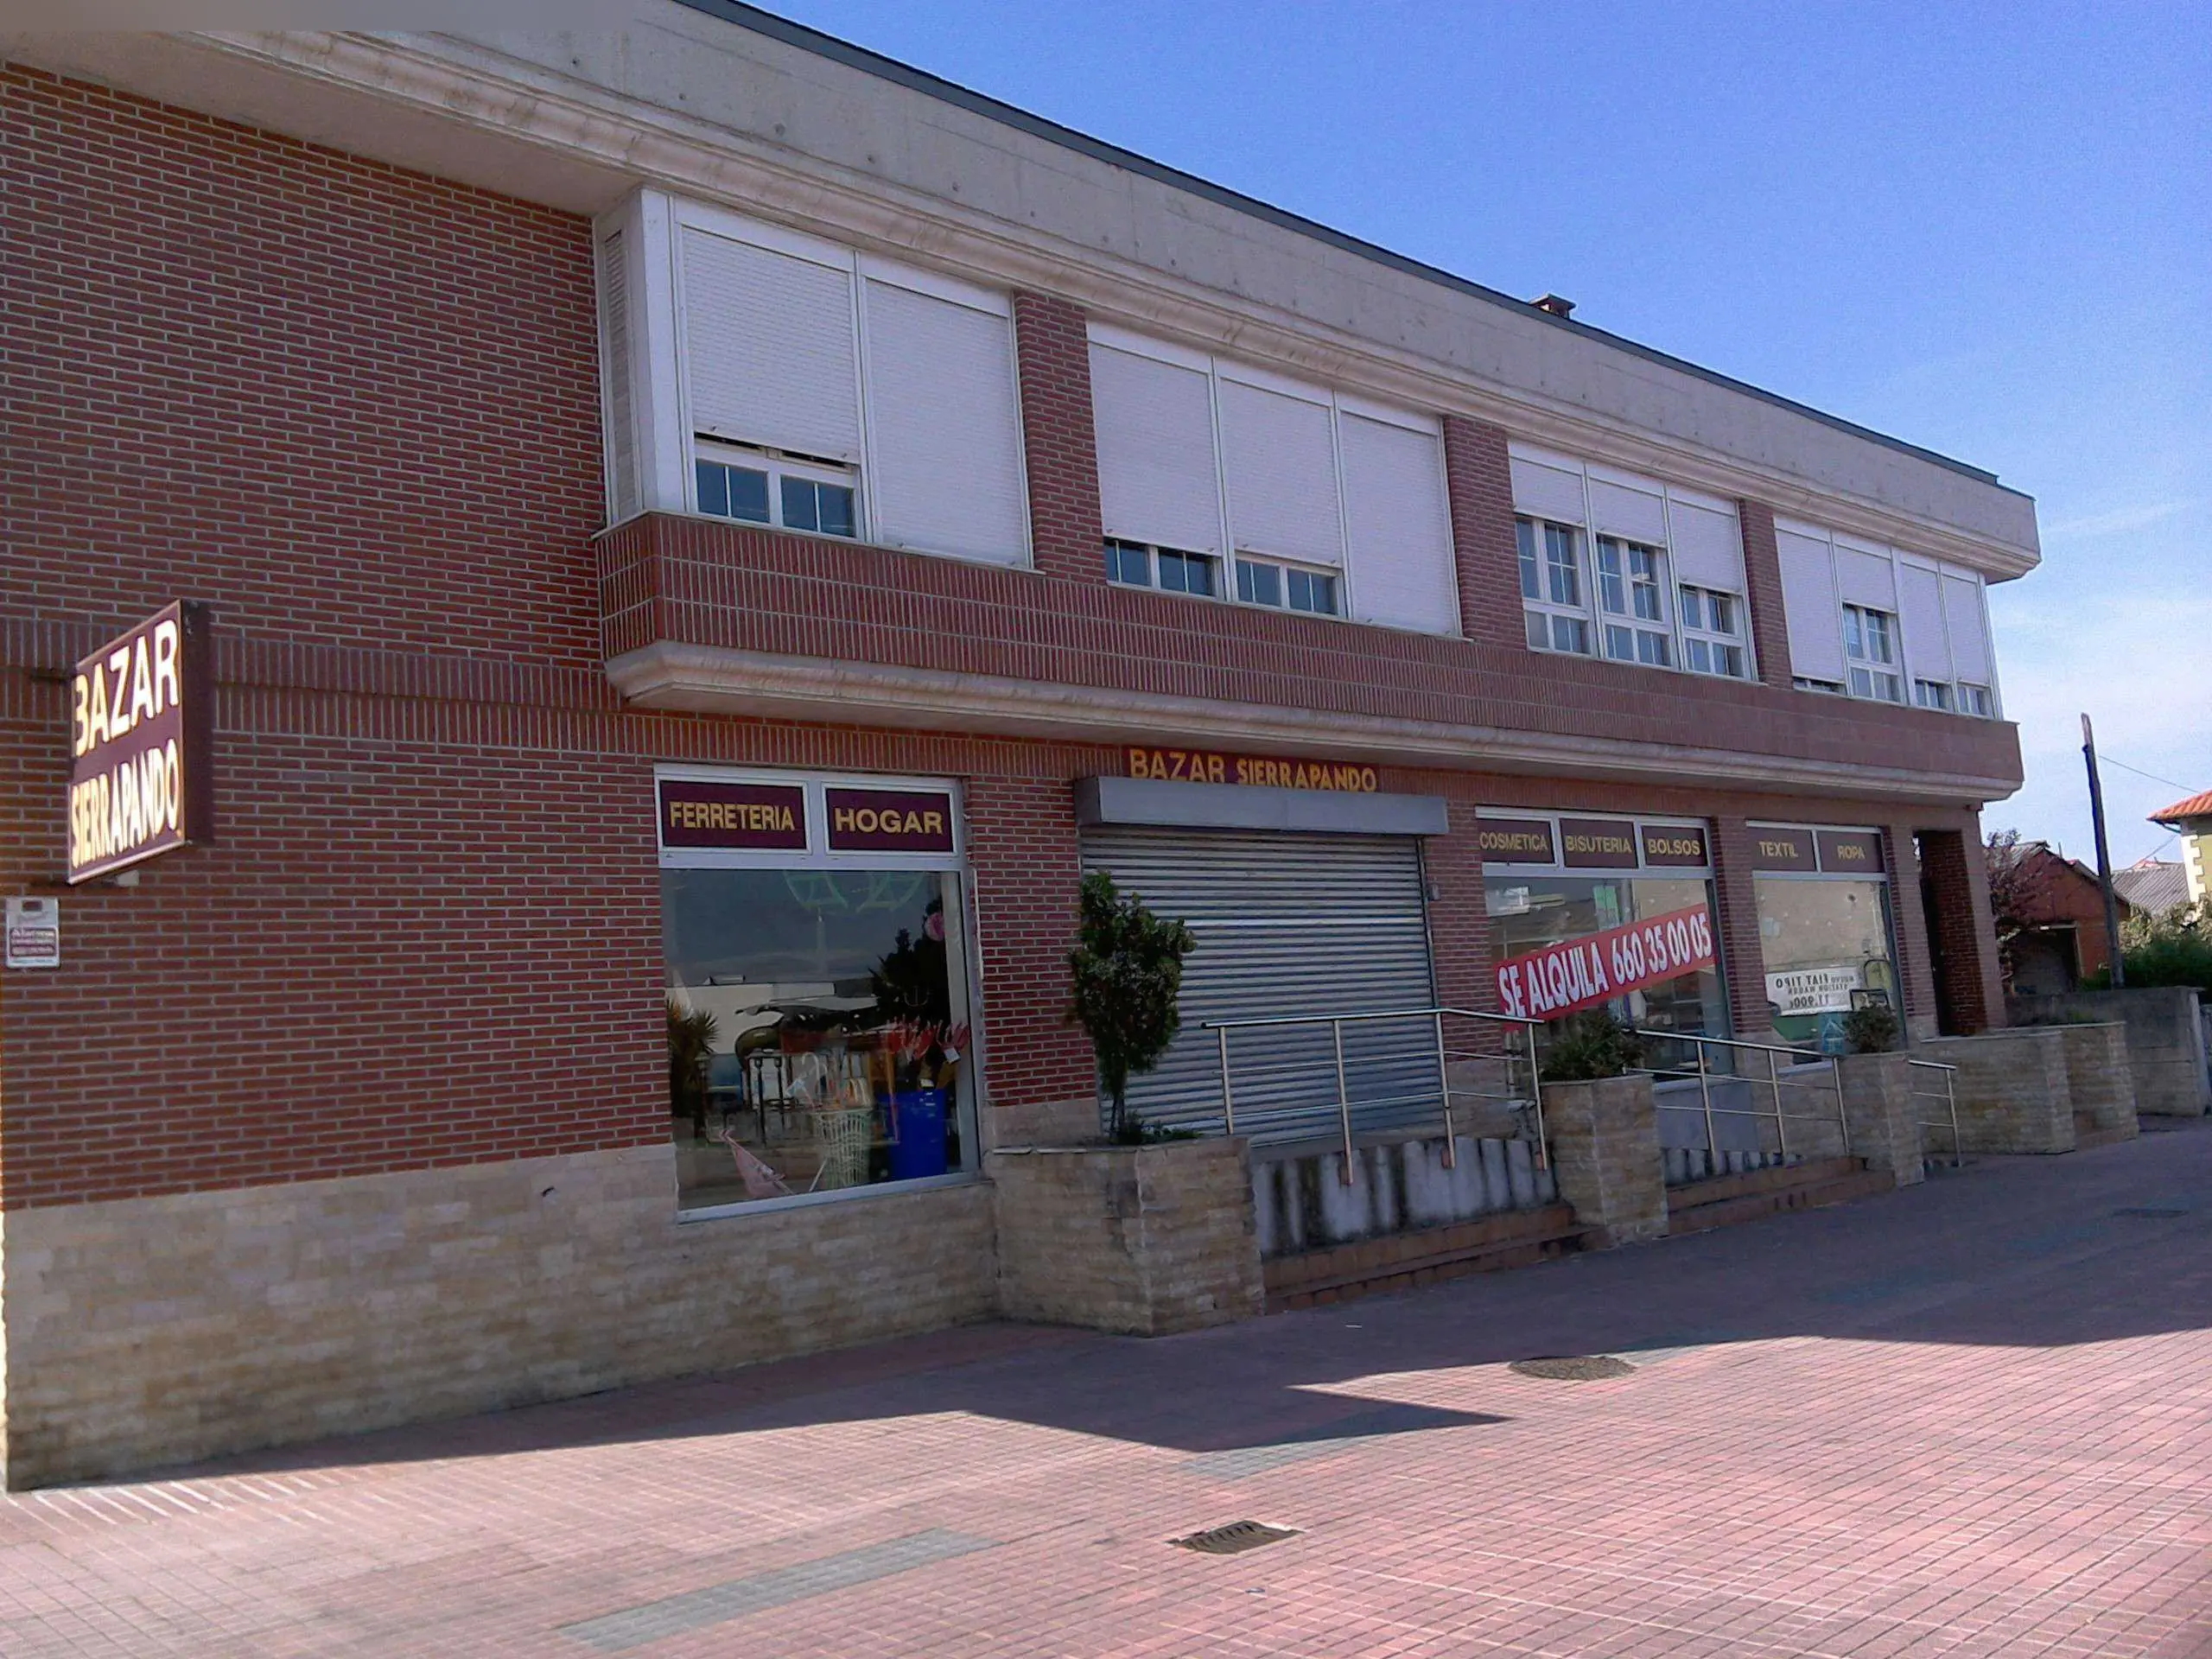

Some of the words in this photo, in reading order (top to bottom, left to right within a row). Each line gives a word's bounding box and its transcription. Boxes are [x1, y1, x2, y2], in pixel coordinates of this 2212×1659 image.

[73, 619, 180, 757] BAZAR
[1129, 748, 1225, 783] BAZAR
[1236, 758, 1377, 792] SIERRAPANDO
[71, 738, 180, 868] SIERRAPANDO
[670, 801, 795, 830] FERRETERIA
[835, 808, 944, 834] HOGAR
[1478, 831, 1548, 851] COSMETICA
[1566, 835, 1632, 854] BISUTERIA
[1648, 838, 1700, 855] BOLSOS
[1759, 842, 1799, 858] TEXTIL
[1837, 845, 1866, 860] ROPA
[1497, 964, 1527, 1018] SE
[1526, 942, 1610, 1015] ALQUILA
[1611, 931, 1645, 985] 660
[1645, 925, 1669, 973] 35
[1666, 918, 1691, 966] 00
[1689, 912, 1713, 958] 05
